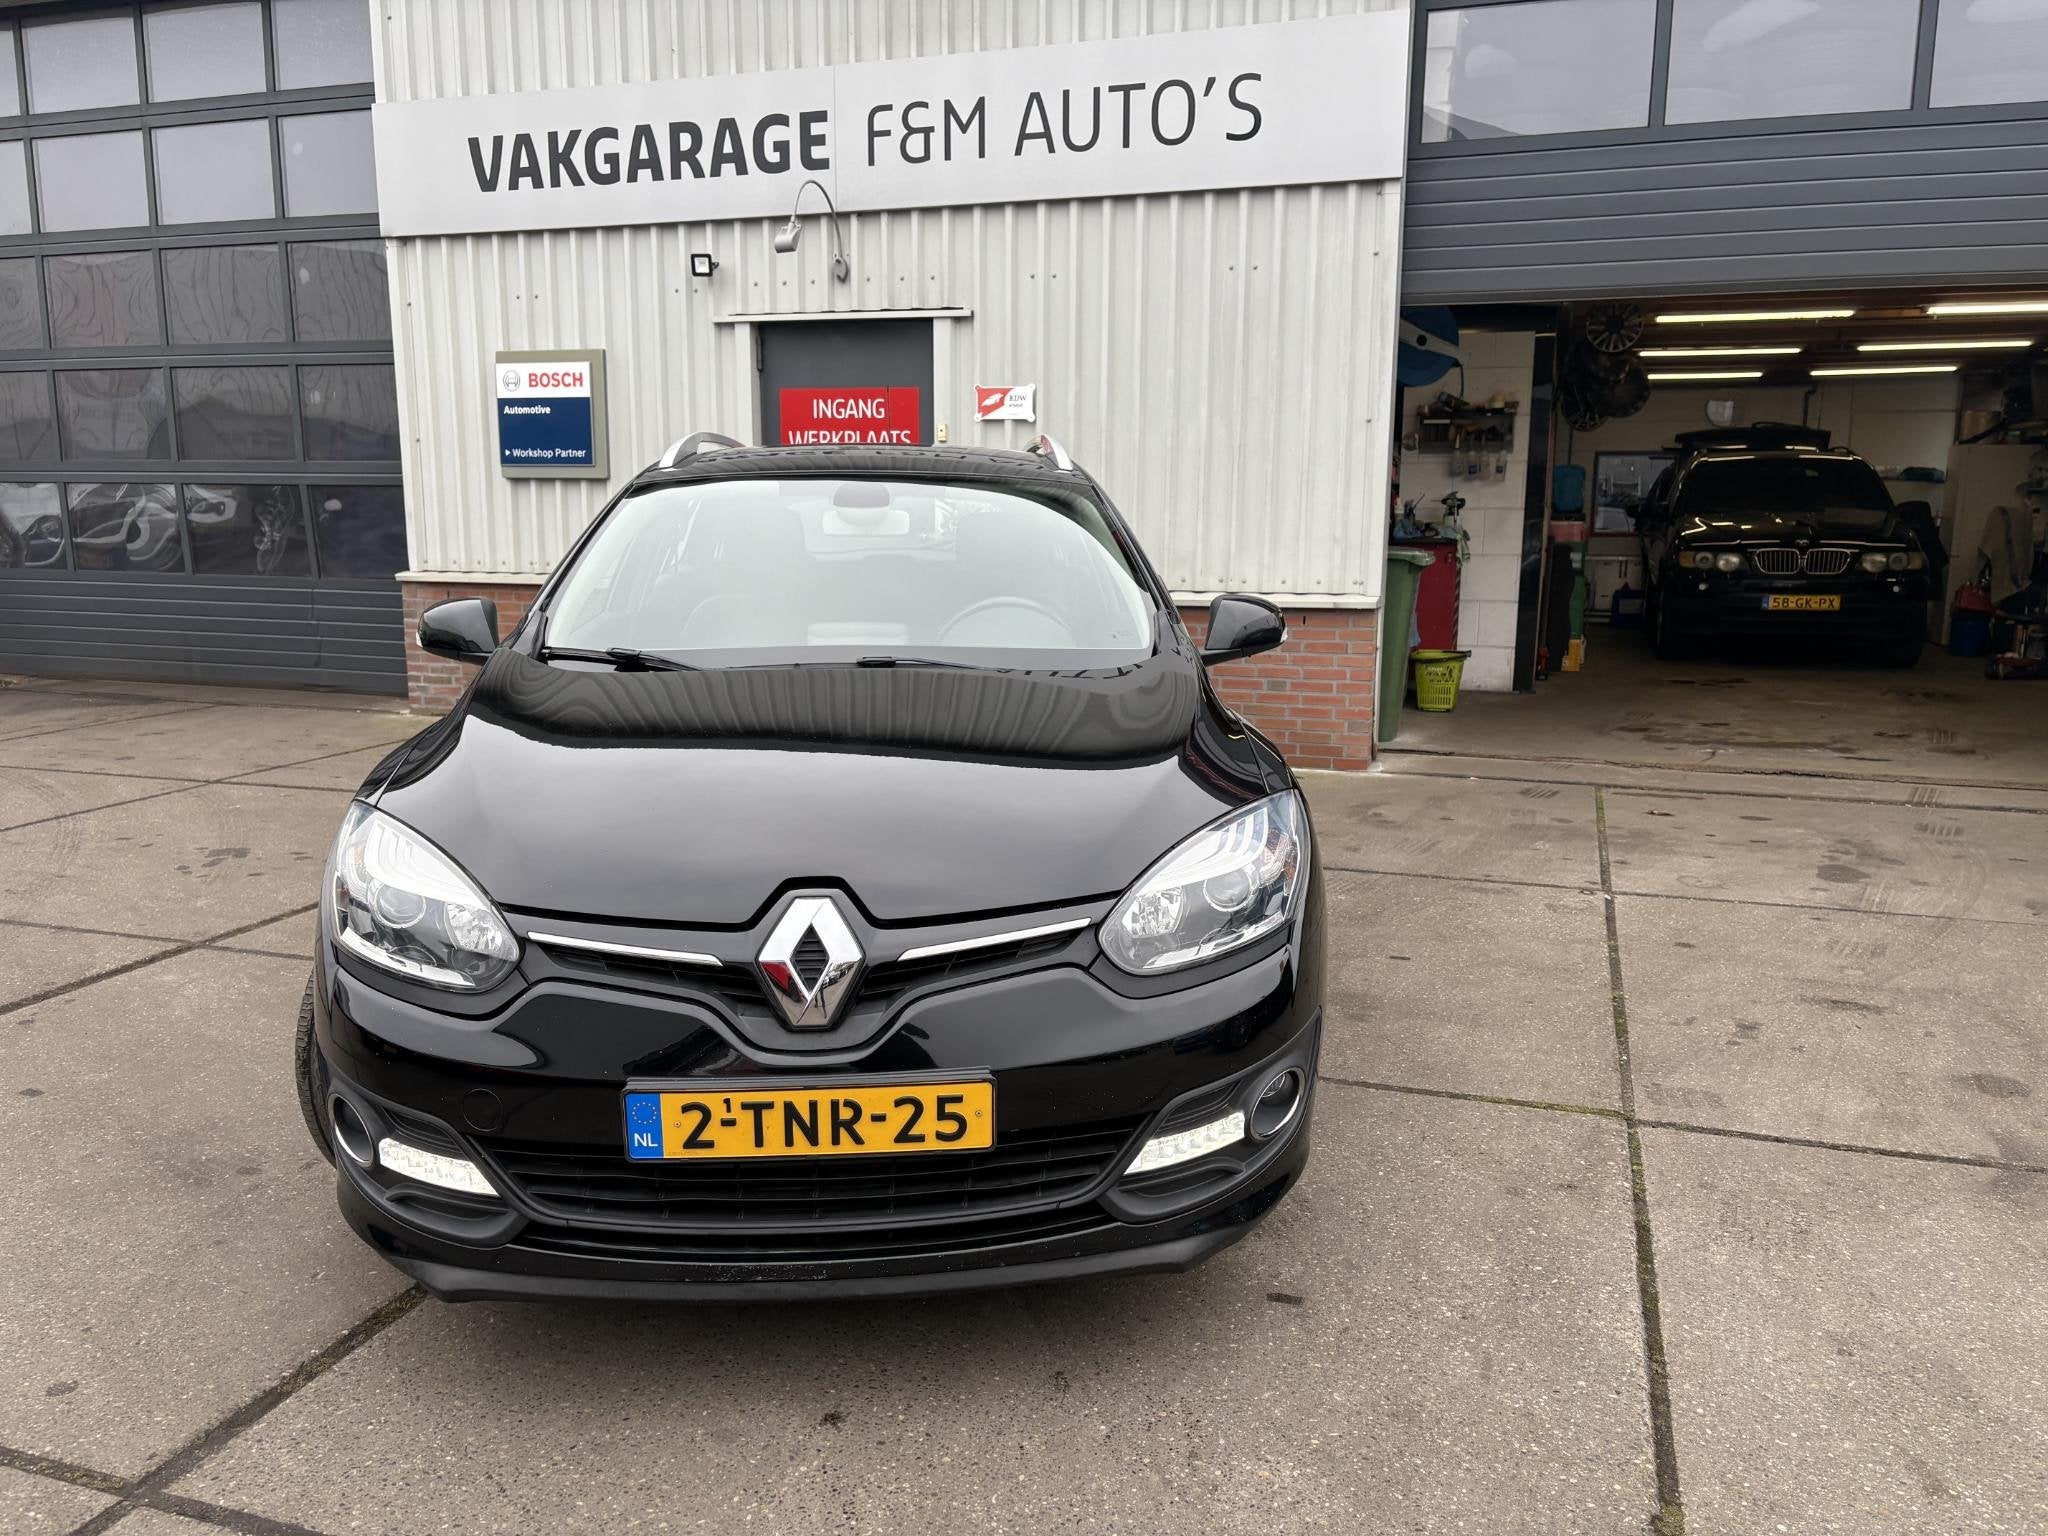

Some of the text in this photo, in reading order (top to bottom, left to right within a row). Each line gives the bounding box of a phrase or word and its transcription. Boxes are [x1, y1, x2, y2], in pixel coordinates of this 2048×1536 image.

[467, 72, 1262, 193] VAKGARAGE F&M AUTO'S
[528, 372, 583, 388] BOSCH
[504, 404, 551, 414] Automotive
[813, 398, 885, 419] INGANG
[788, 430, 911, 445] WERKPLAATS
[512, 447, 586, 459] Workshop Partner
[1772, 597, 1836, 609] 58-GK-PX
[634, 1132, 659, 1148] NL
